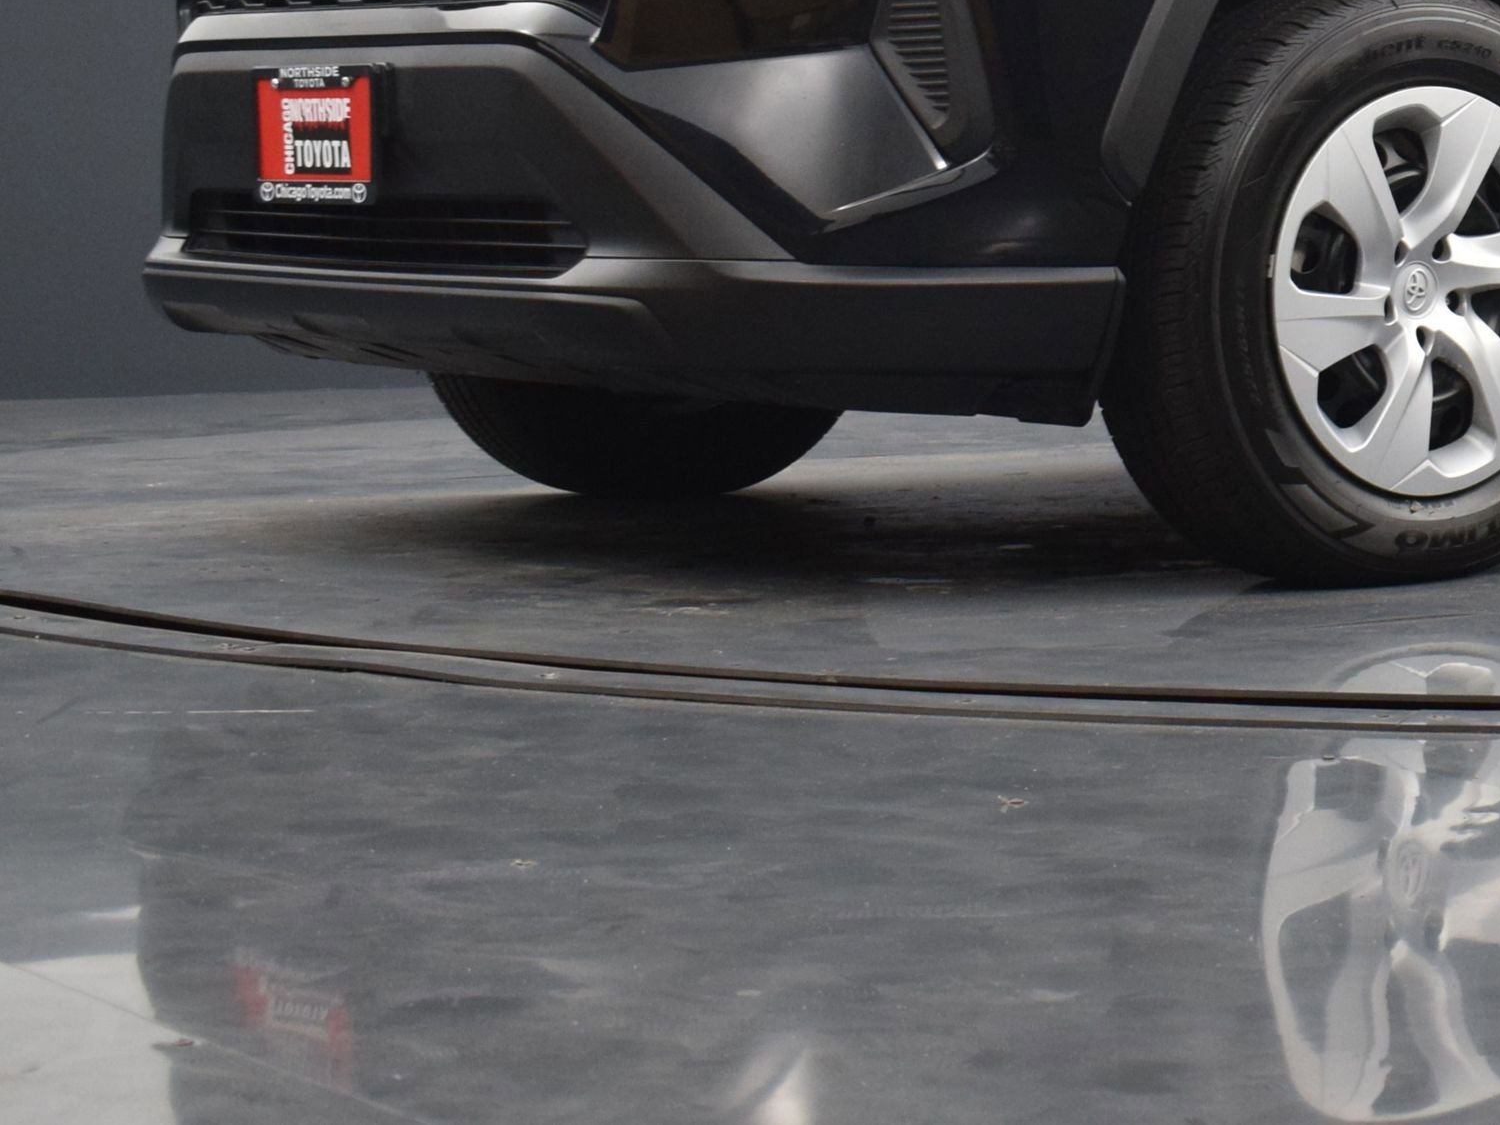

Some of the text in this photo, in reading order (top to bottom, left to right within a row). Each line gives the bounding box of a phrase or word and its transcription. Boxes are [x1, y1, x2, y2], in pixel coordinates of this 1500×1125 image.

[279, 66, 340, 78] NORTHSIDE
[293, 78, 326, 88] TOYOTA
[290, 98, 352, 123] NORTHSIDE
[281, 98, 295, 175] CHICAGO
[294, 139, 352, 168] TOYOTA
[275, 183, 352, 203] ChicagoToyota.com
